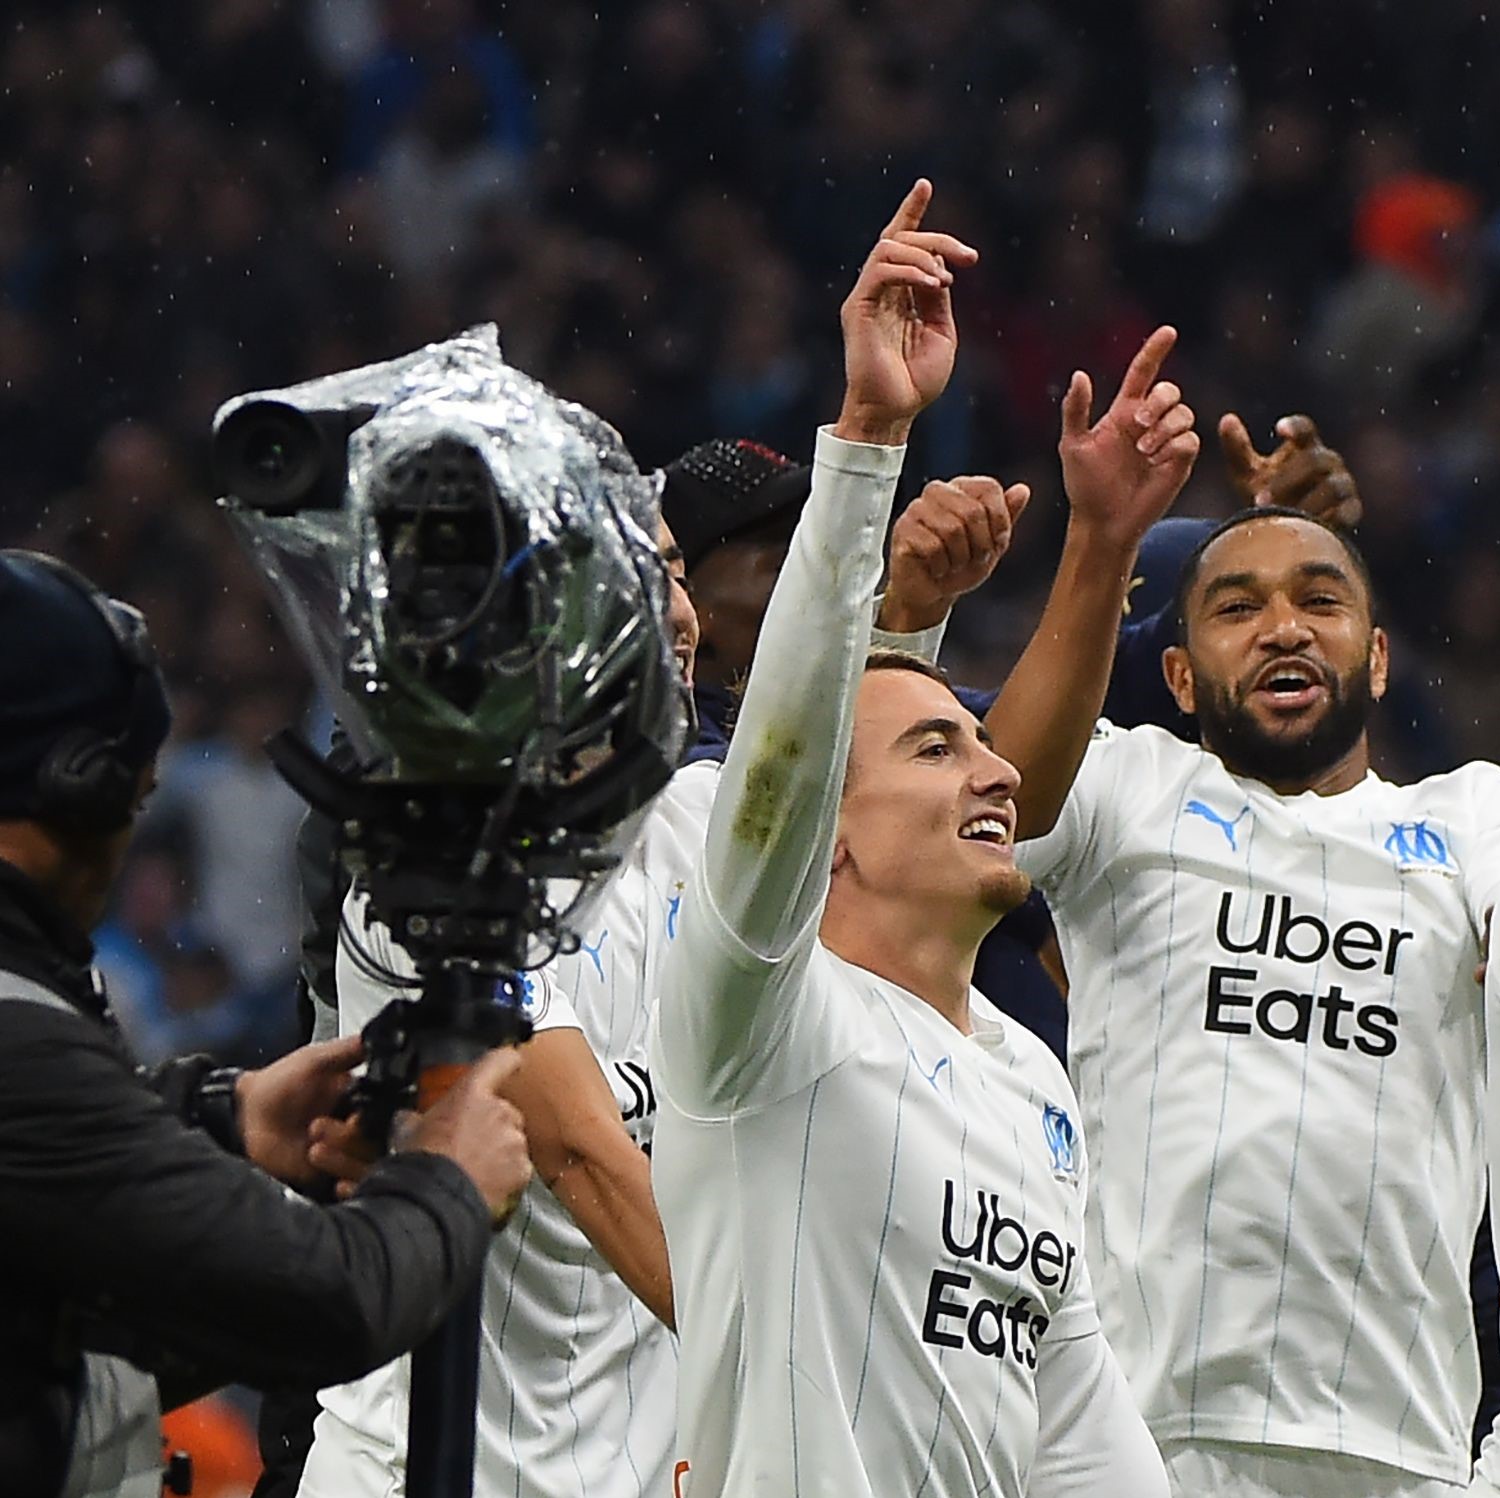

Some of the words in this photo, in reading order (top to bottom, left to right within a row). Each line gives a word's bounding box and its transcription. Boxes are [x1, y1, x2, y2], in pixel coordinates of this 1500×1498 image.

[1216, 892, 1413, 975] Uber
[1205, 966, 1398, 1057] Eats
[942, 1179, 1075, 1294] Uber
[922, 1269, 1049, 1370] Eats
